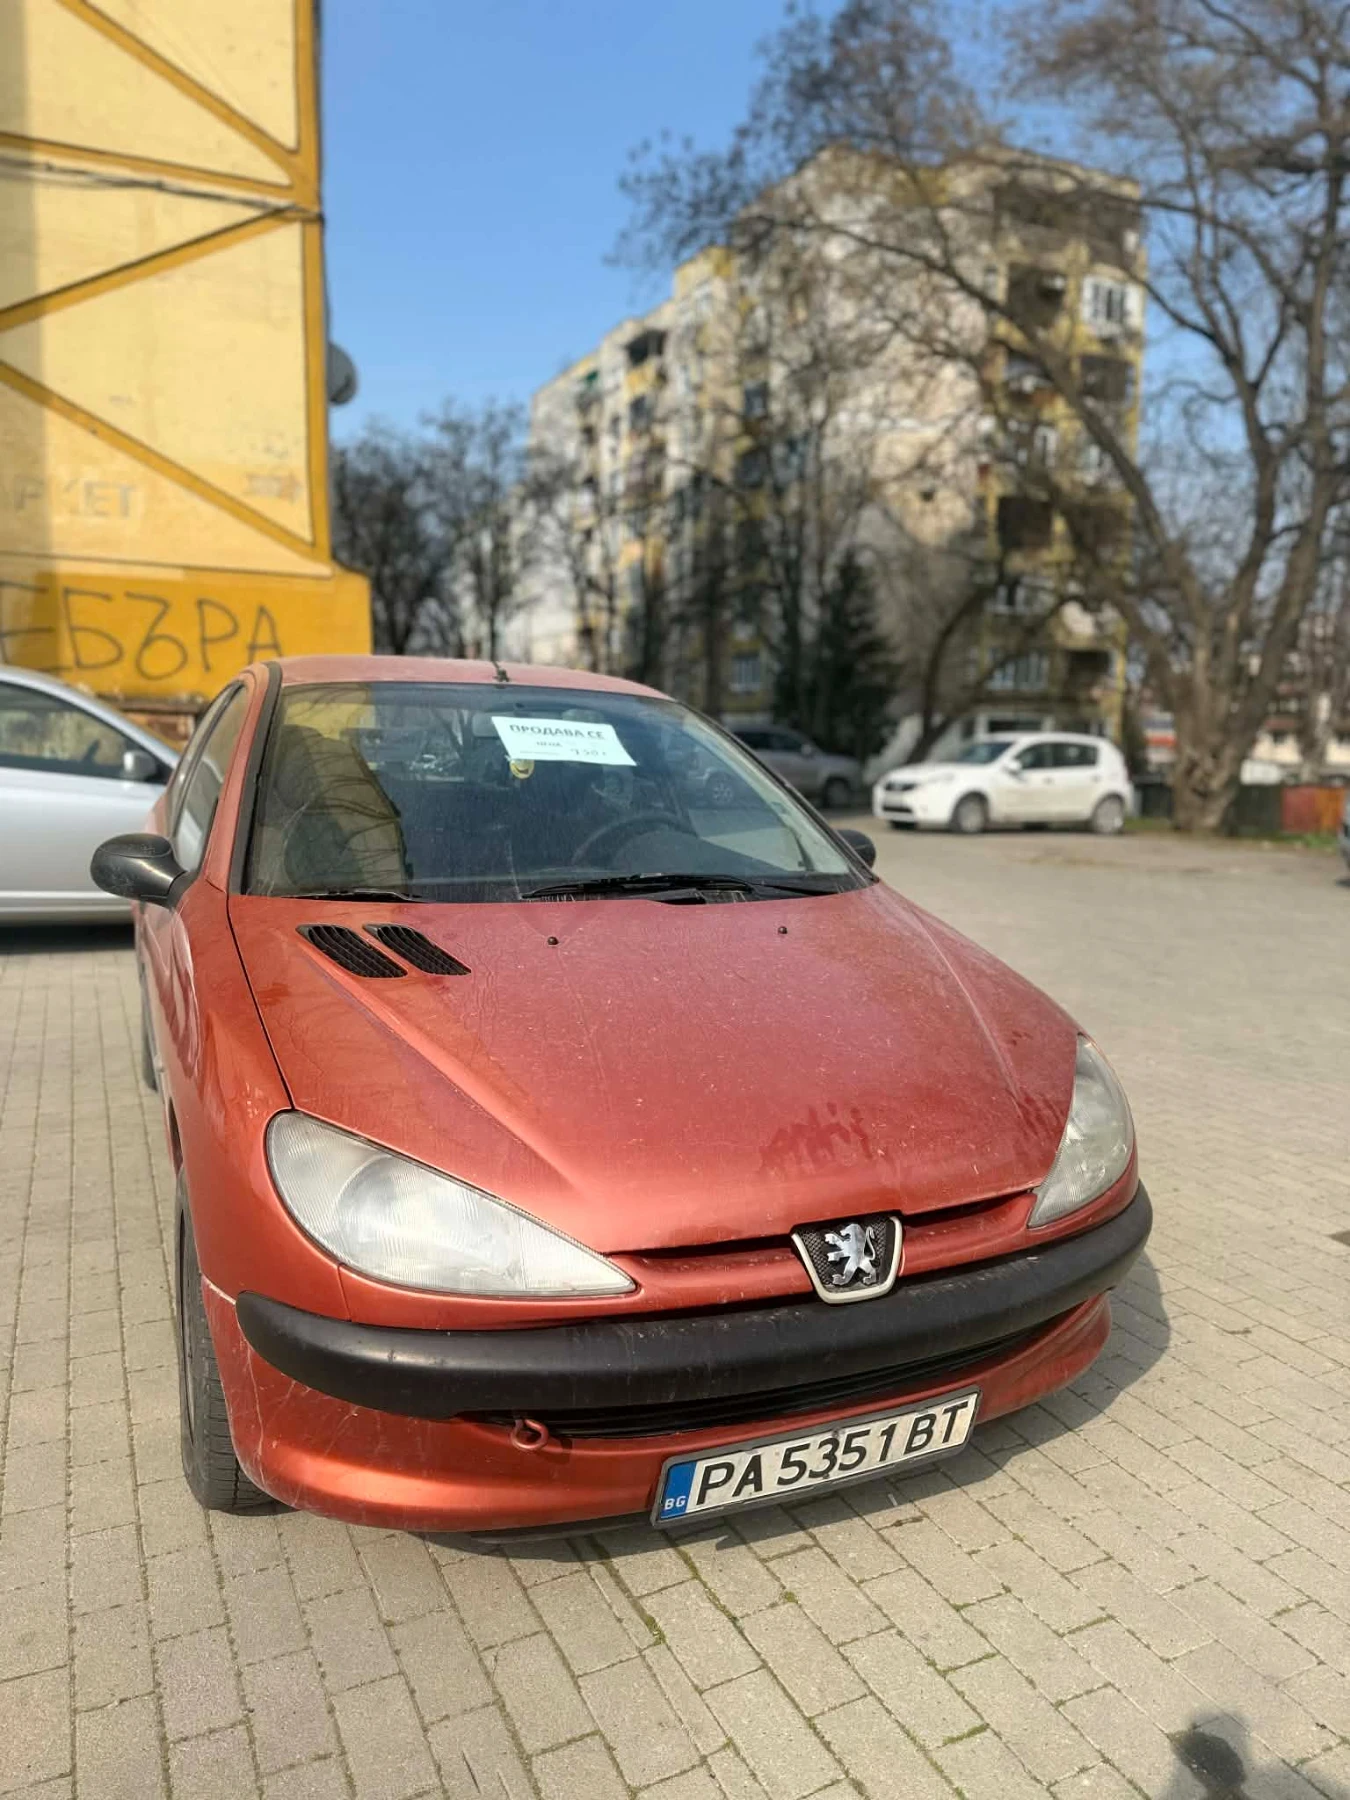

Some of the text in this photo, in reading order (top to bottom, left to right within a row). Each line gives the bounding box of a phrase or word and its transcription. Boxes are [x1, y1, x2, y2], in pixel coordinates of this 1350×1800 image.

[509, 723, 606, 740] ПРОДАВА СЕ
[695, 1400, 969, 1506] PA 5351 BT
[664, 1495, 686, 1511] BG
